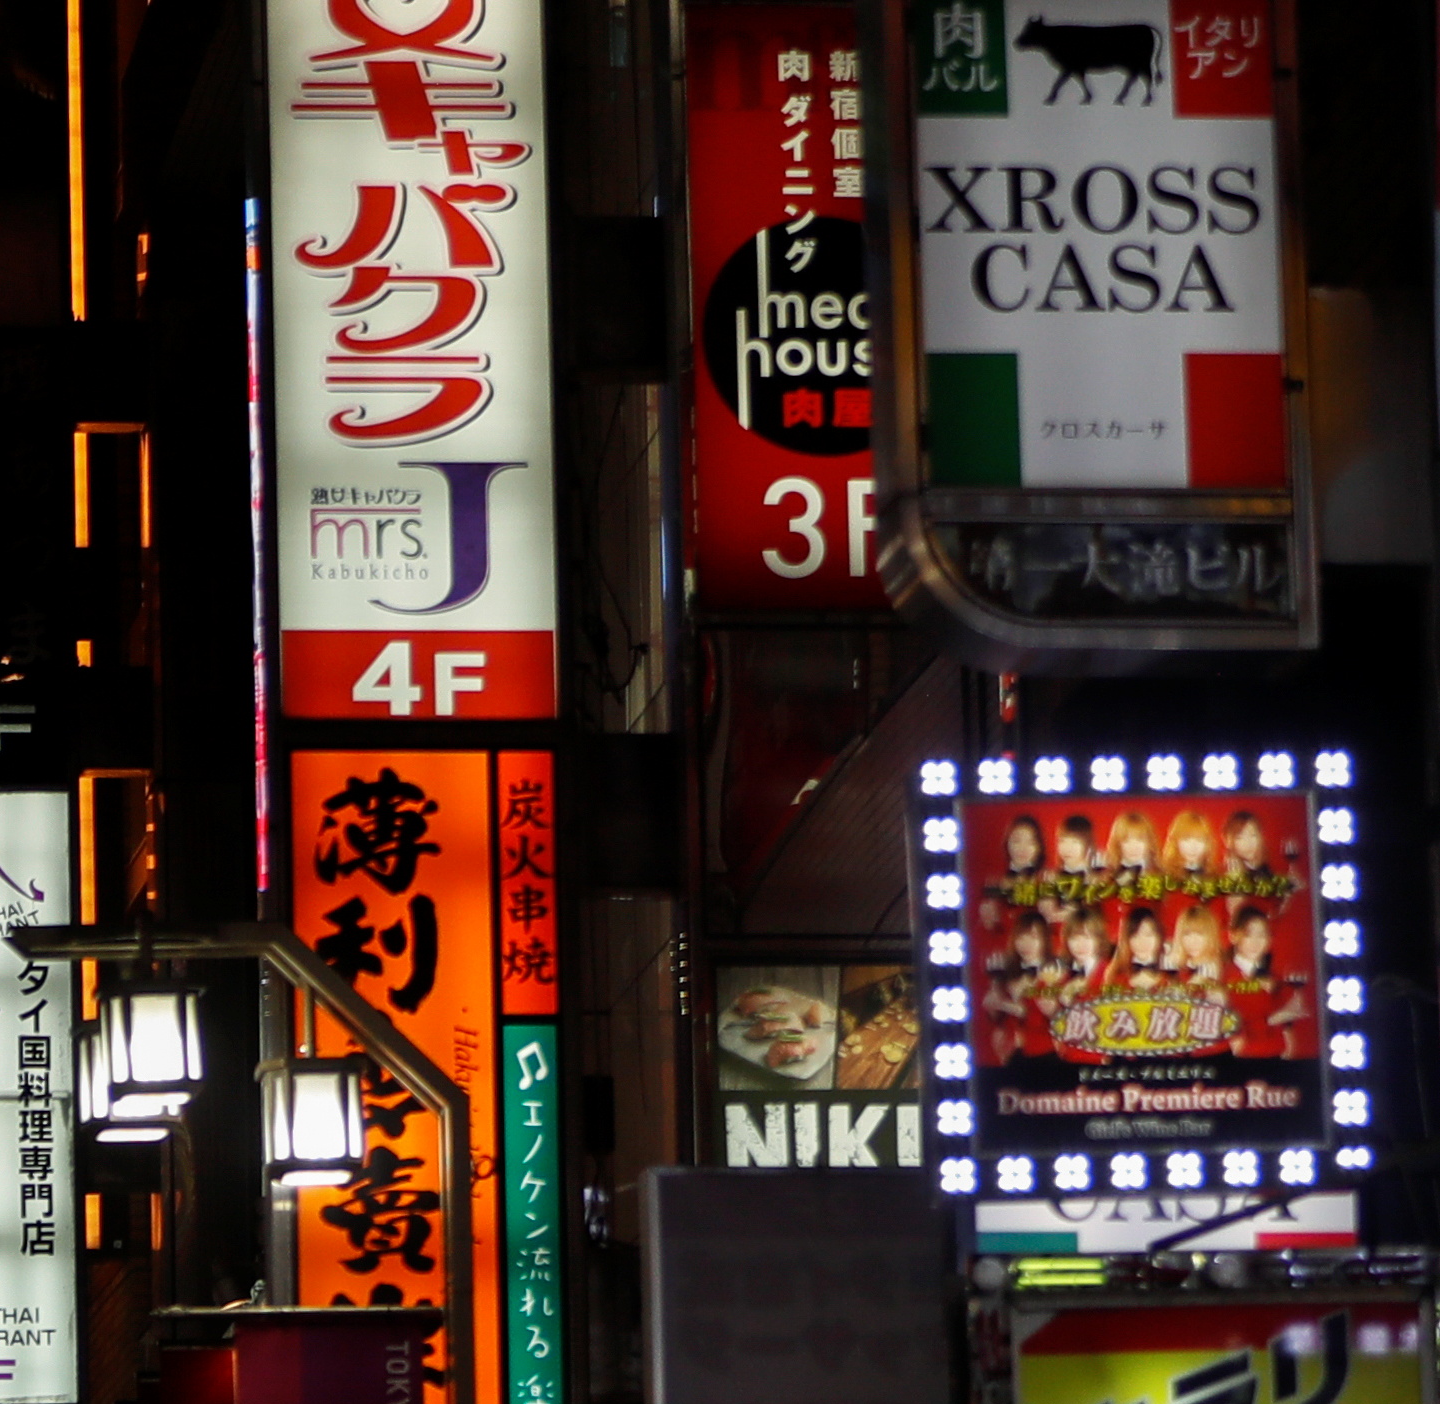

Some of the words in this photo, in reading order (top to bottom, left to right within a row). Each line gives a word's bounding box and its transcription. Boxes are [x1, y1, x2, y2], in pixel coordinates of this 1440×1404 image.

[932, 9, 989, 55] 肉
[921, 63, 1000, 94] バル
[924, 165, 1263, 236] XROSS
[969, 244, 1236, 314] CASA
[1039, 420, 1168, 441] クロスカーサ
[310, 562, 430, 581] Kabukicho
[352, 640, 486, 717] 4F
[502, 779, 555, 986] 炭火串焼
[1065, 1006, 1223, 1042] 飲み放題
[17, 959, 56, 1257] タイ国料理専門店
[996, 1086, 1117, 1115] Domaine
[1121, 1083, 1240, 1112] Premiere
[1245, 1081, 1302, 1108] Rue
